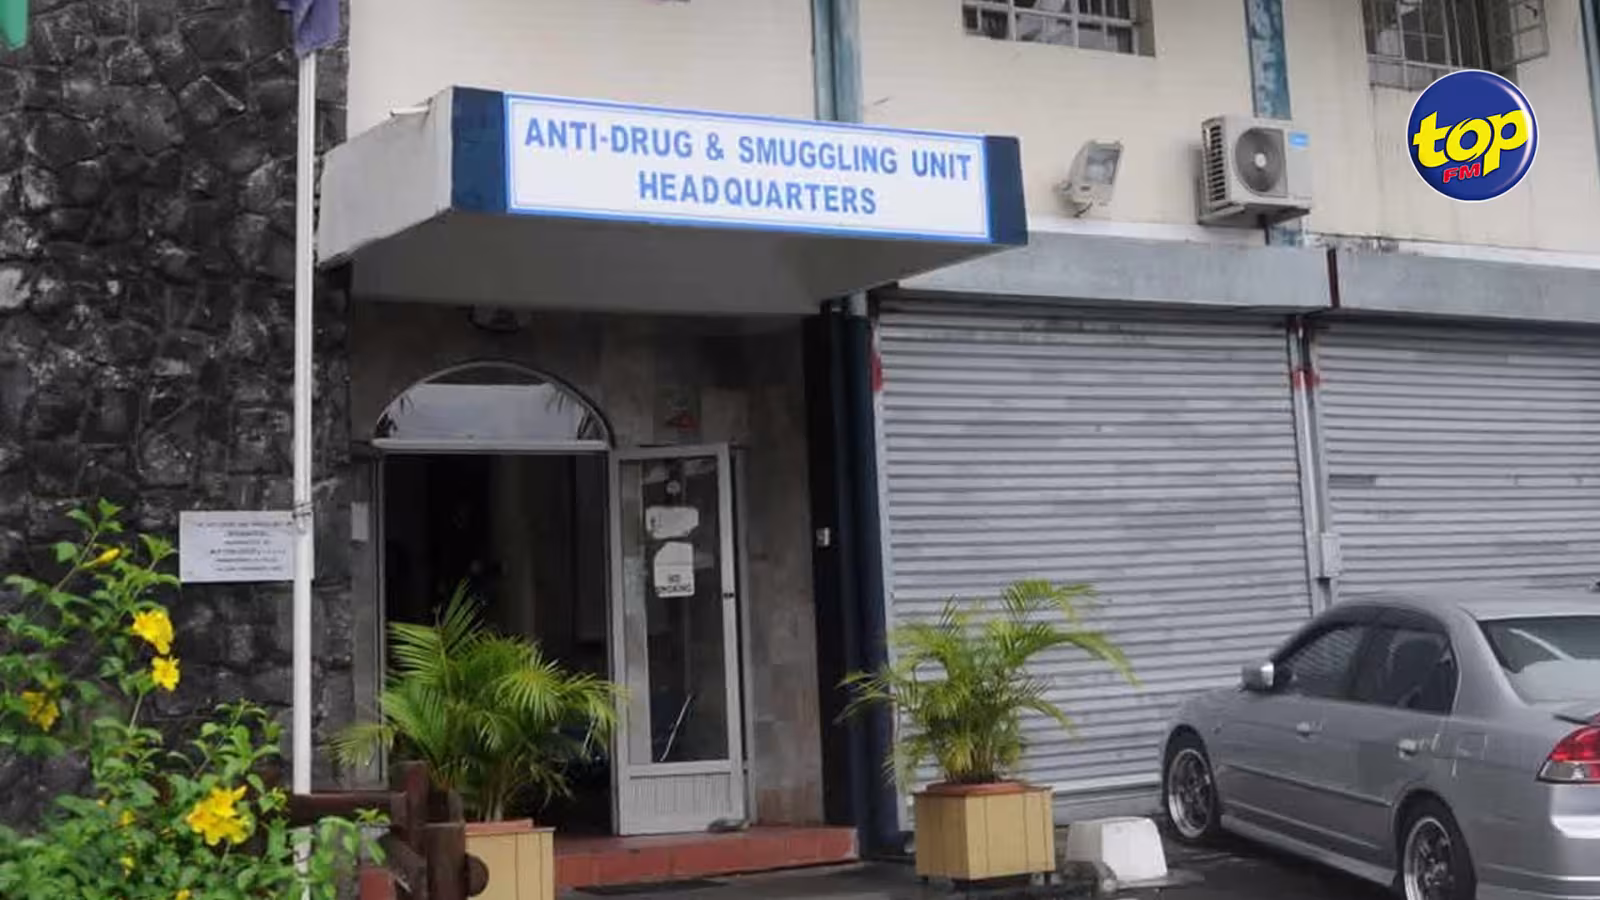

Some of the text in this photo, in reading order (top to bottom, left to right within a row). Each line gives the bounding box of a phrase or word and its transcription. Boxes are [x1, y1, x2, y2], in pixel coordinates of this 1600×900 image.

[524, 117, 971, 181] ANTI-DRUG & SMUGGLING UNIT
[638, 170, 877, 214] HEADQUARTERS
